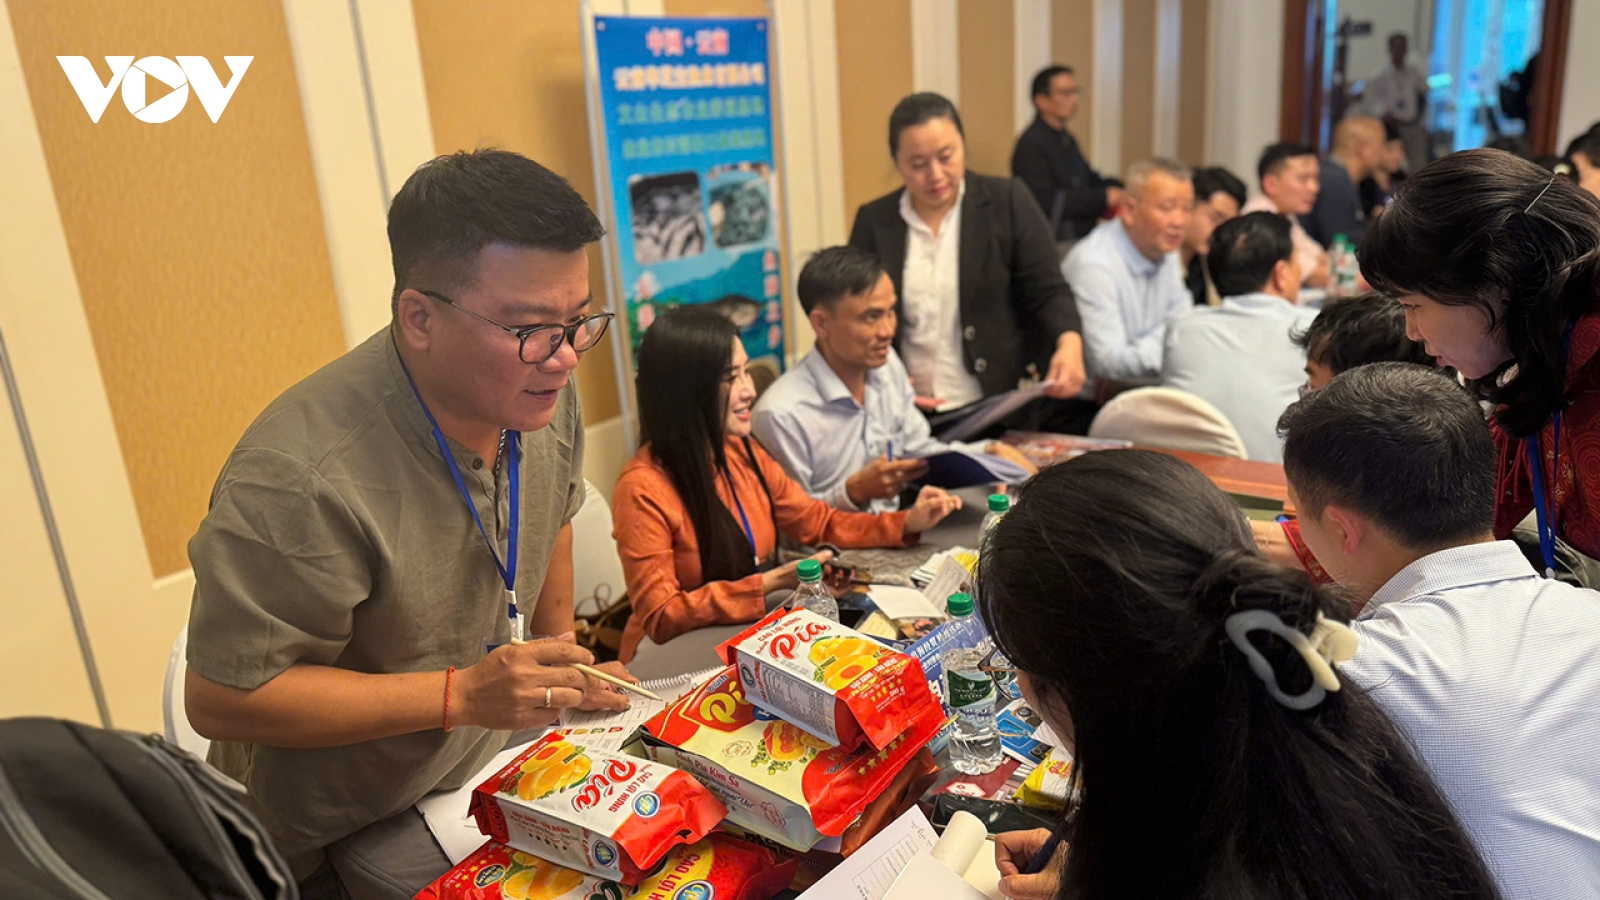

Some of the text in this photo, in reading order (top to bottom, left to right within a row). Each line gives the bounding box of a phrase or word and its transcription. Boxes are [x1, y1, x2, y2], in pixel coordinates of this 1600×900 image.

[770, 621, 829, 660] Pía
[700, 681, 751, 724] Pí
[576, 759, 637, 811] Pía
[636, 771, 653, 784] CAO
[675, 853, 701, 874] CAO
[657, 873, 682, 893] LỢI
